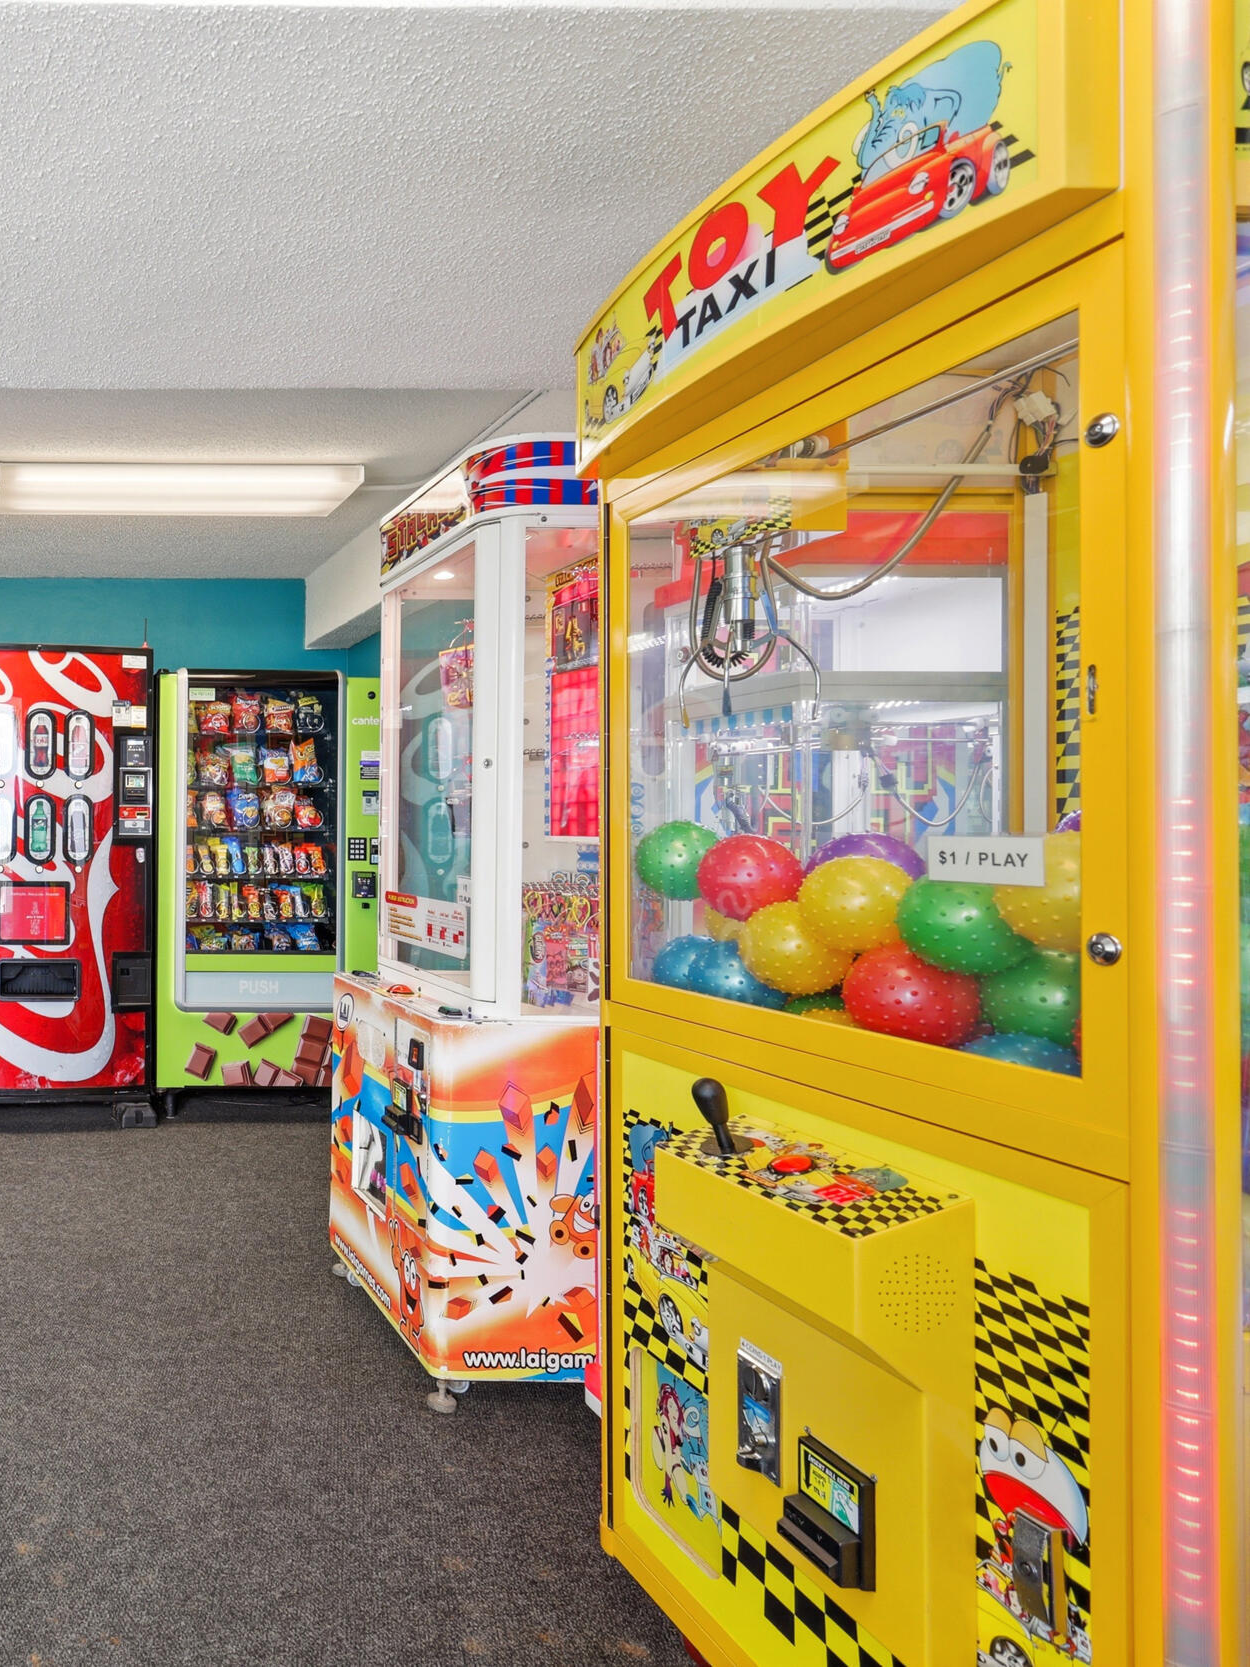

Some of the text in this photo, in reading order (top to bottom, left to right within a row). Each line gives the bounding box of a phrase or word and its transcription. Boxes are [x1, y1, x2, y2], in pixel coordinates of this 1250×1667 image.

[643, 156, 840, 341] TOY
[677, 248, 776, 348] TAXI
[938, 850, 956, 865] $1
[978, 852, 1028, 868] PLAY
[238, 979, 279, 994] PUSH
[463, 1347, 595, 1374] www.laigam
